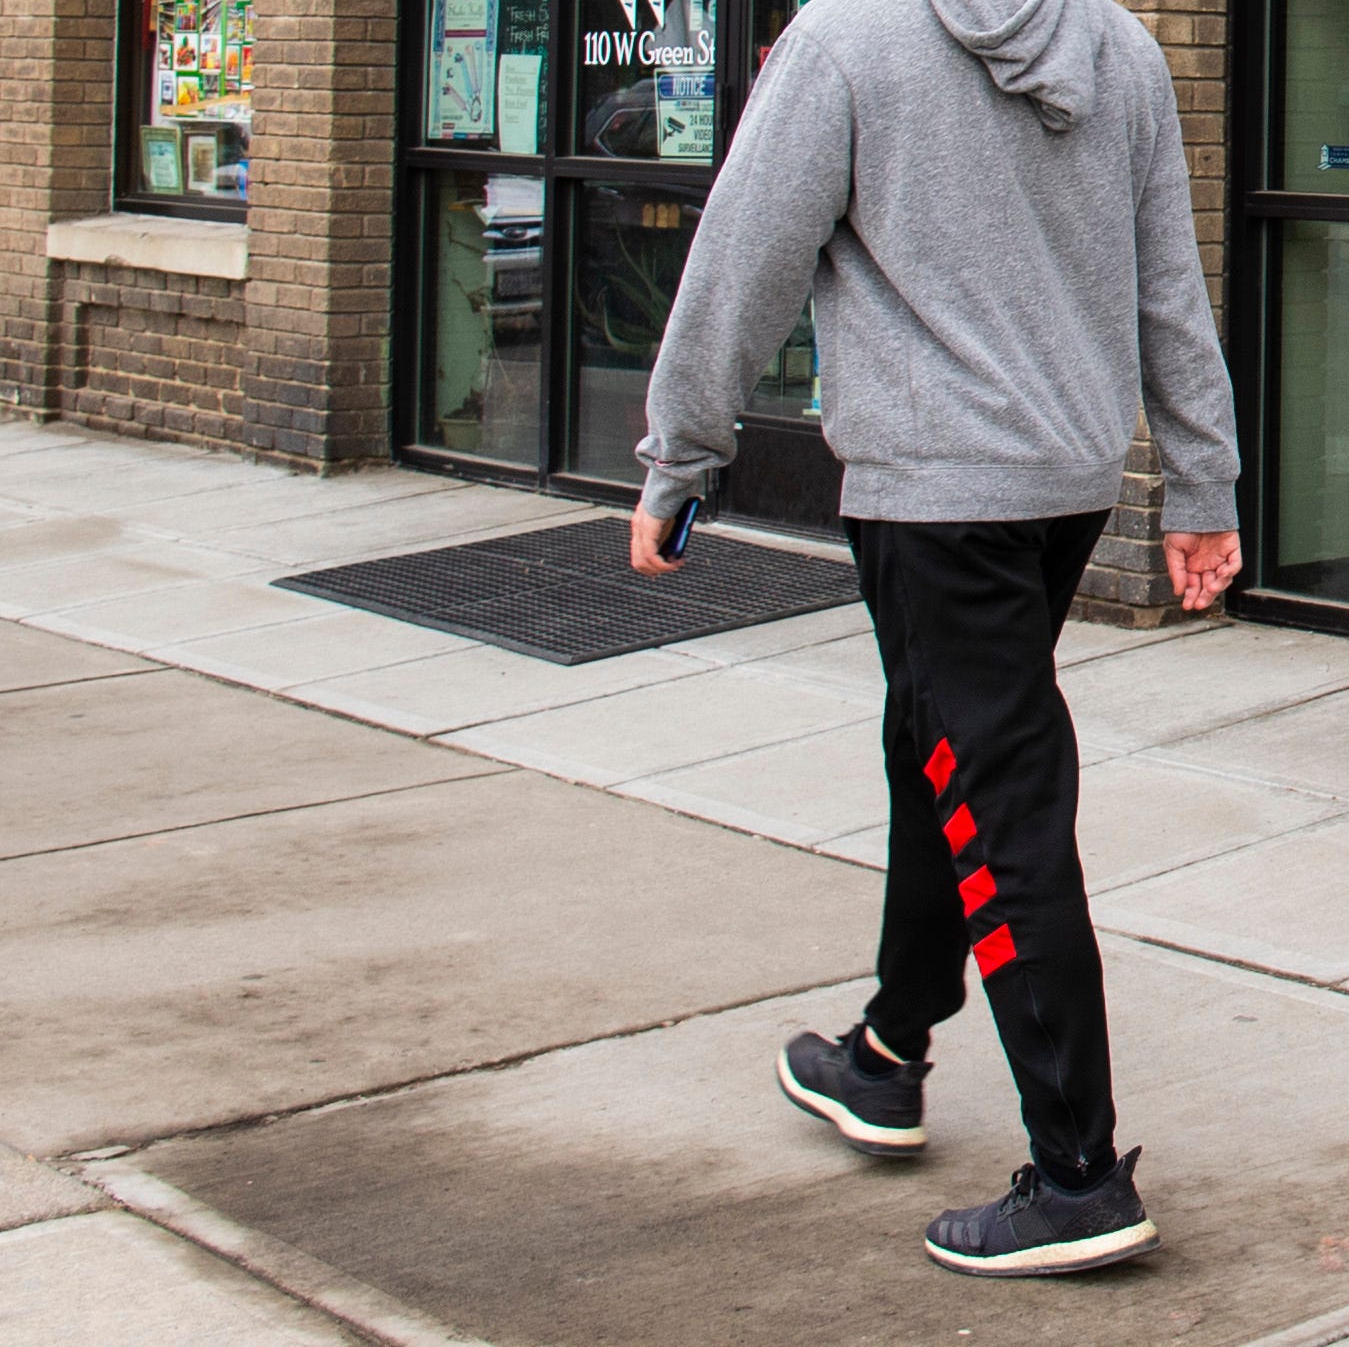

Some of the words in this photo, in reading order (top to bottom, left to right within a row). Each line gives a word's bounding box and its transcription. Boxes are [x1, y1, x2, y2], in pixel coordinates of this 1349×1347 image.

[584, 31, 610, 65] 110
[613, 31, 638, 66] W
[638, 30, 694, 65] Green
[672, 76, 706, 96] NOTICE
[689, 115, 698, 126] 24
